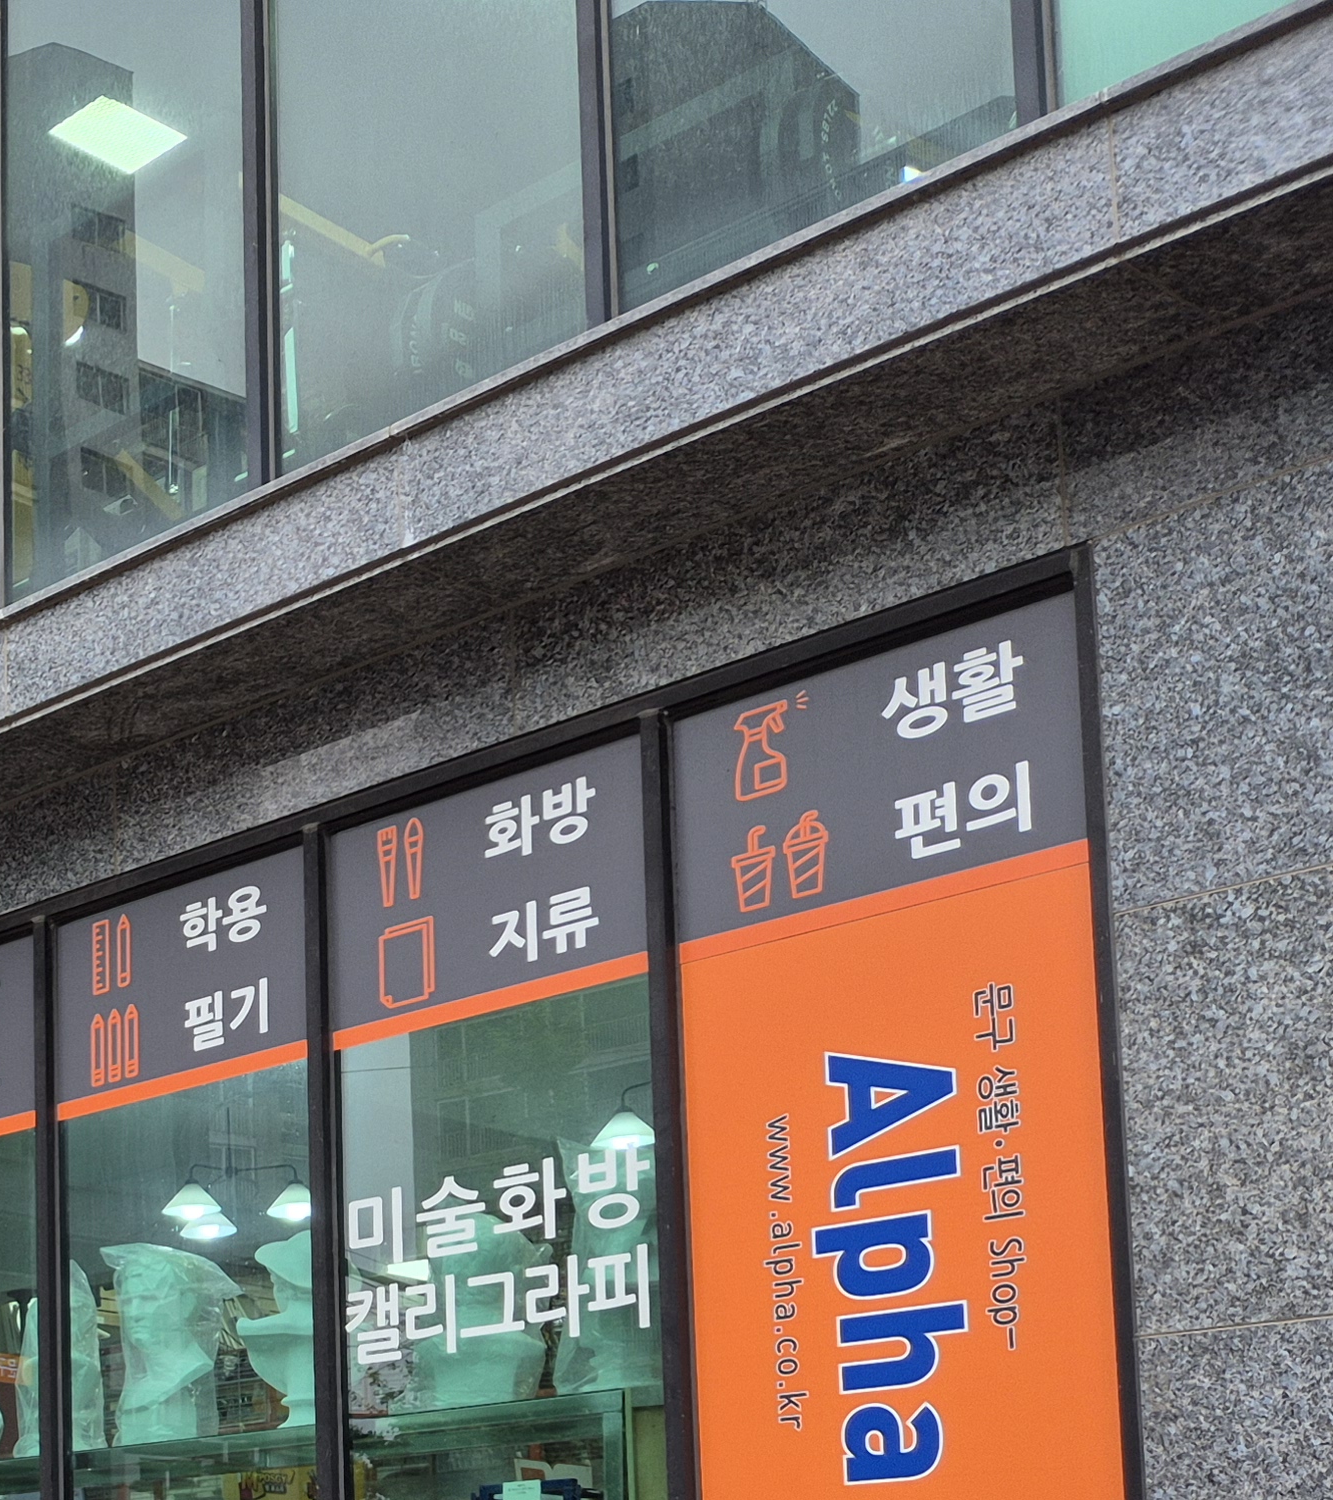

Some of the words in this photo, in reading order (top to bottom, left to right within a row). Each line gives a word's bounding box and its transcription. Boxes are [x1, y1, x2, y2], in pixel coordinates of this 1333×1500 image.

[881, 639, 1024, 739] 생활
[483, 778, 595, 858] 화방
[894, 760, 1033, 860] 편의
[179, 885, 269, 951] 학용
[487, 886, 602, 964] 지류
[184, 976, 271, 1054] 필기
[973, 983, 1016, 1052] 문구
[348, 1142, 651, 1264] 미술화방
[345, 1243, 651, 1365] 캘리그라피
[764, 1114, 809, 1431] www.alpha.co.kr
[812, 1051, 969, 1485] Alpha
